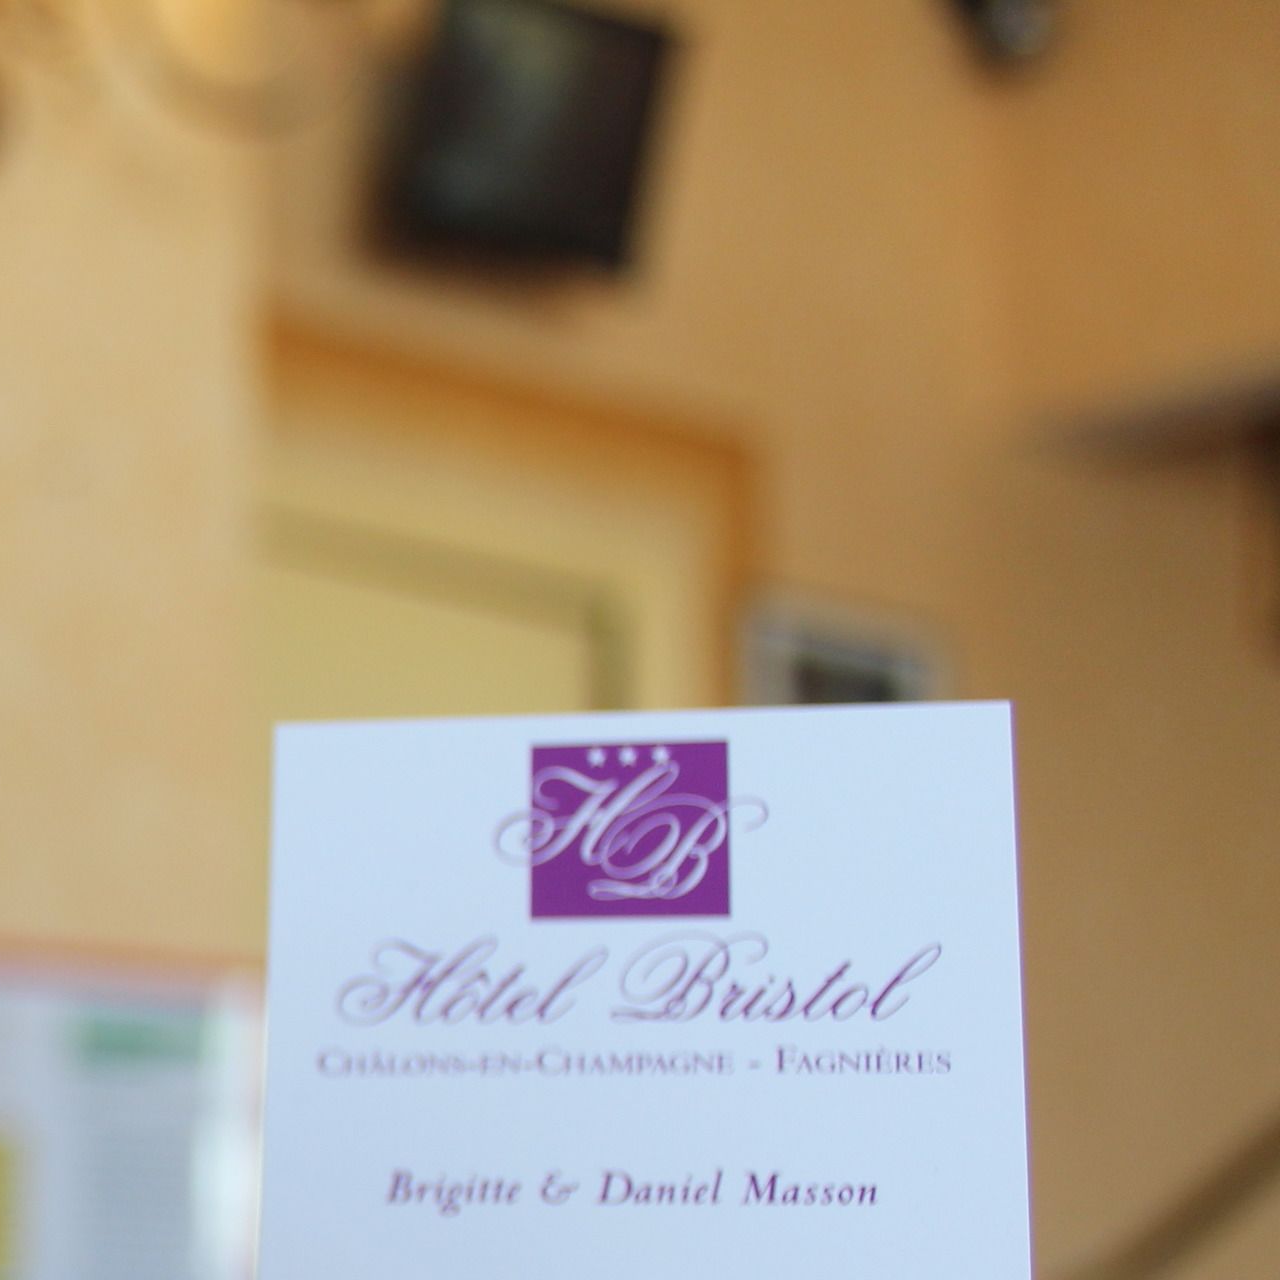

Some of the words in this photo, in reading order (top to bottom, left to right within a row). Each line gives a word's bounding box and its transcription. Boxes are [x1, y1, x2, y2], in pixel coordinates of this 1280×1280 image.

[337, 936, 610, 1027] Hôtel
[610, 932, 943, 1024] Bristol
[387, 1168, 521, 1216] Brigitte
[539, 1171, 580, 1206] &
[597, 1169, 724, 1207] Daniel
[743, 1172, 880, 1206] Masson
